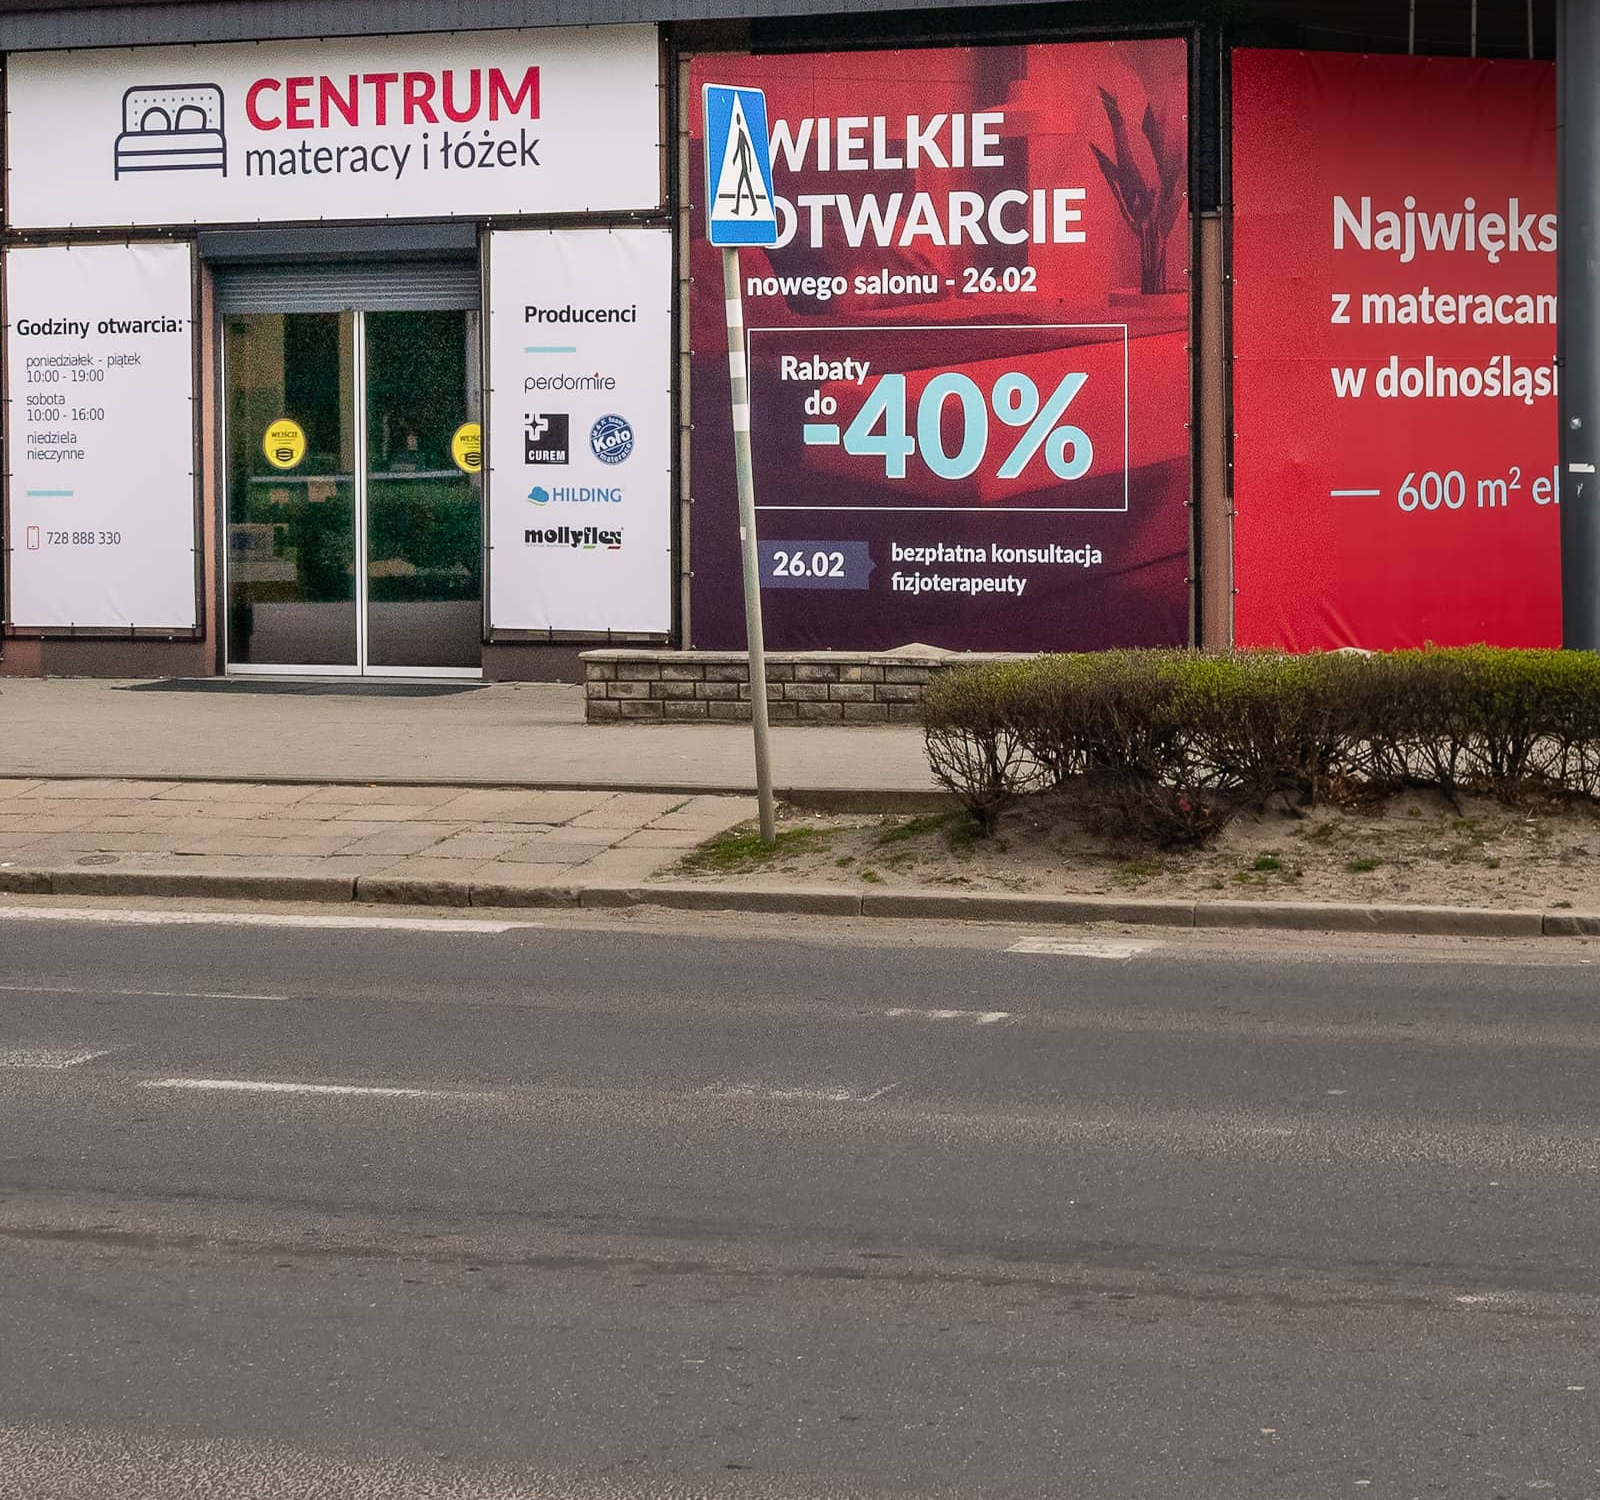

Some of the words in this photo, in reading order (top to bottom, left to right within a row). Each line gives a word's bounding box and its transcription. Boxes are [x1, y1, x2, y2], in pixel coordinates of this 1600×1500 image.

[244, 66, 541, 130] CENTRUM
[771, 112, 1004, 172] WIELKIE
[245, 138, 411, 179] materacy
[422, 132, 430, 169] i
[440, 128, 540, 168] łóżek
[747, 276, 848, 300] nowego
[854, 269, 938, 295] salonu
[963, 267, 1037, 293] 26.02
[524, 305, 637, 325] Producenci
[1331, 293, 1350, 324] z
[1361, 286, 1557, 324] materacam
[16, 318, 90, 338] Godziny
[97, 316, 183, 334] otwarcia:
[26, 354, 94, 368] poniedziałek
[107, 353, 141, 368] piątek
[781, 355, 870, 386] Rabaty
[27, 370, 59, 382] 10:00
[72, 369, 104, 382] 19:00
[524, 372, 616, 393] perdormire
[1331, 369, 1365, 398] w
[27, 393, 65, 405] sobota
[804, 389, 837, 415] do
[27, 409, 59, 421] 10:00
[72, 408, 105, 420] 16:00
[803, 372, 1093, 479] -40%
[27, 432, 77, 444] niedziela
[27, 448, 85, 462] nieczynne
[528, 450, 566, 461] CUREM
[553, 487, 622, 503] HILDING
[1397, 471, 1465, 511] 600
[47, 532, 69, 544] 728
[73, 532, 95, 544] 888
[98, 532, 121, 544] 330
[524, 526, 622, 548] mollyflex
[772, 552, 845, 577] 26.02
[891, 543, 987, 563] bezpłatna
[992, 543, 1102, 565] konsultacja
[891, 574, 1027, 595] fizjoterapeuty
